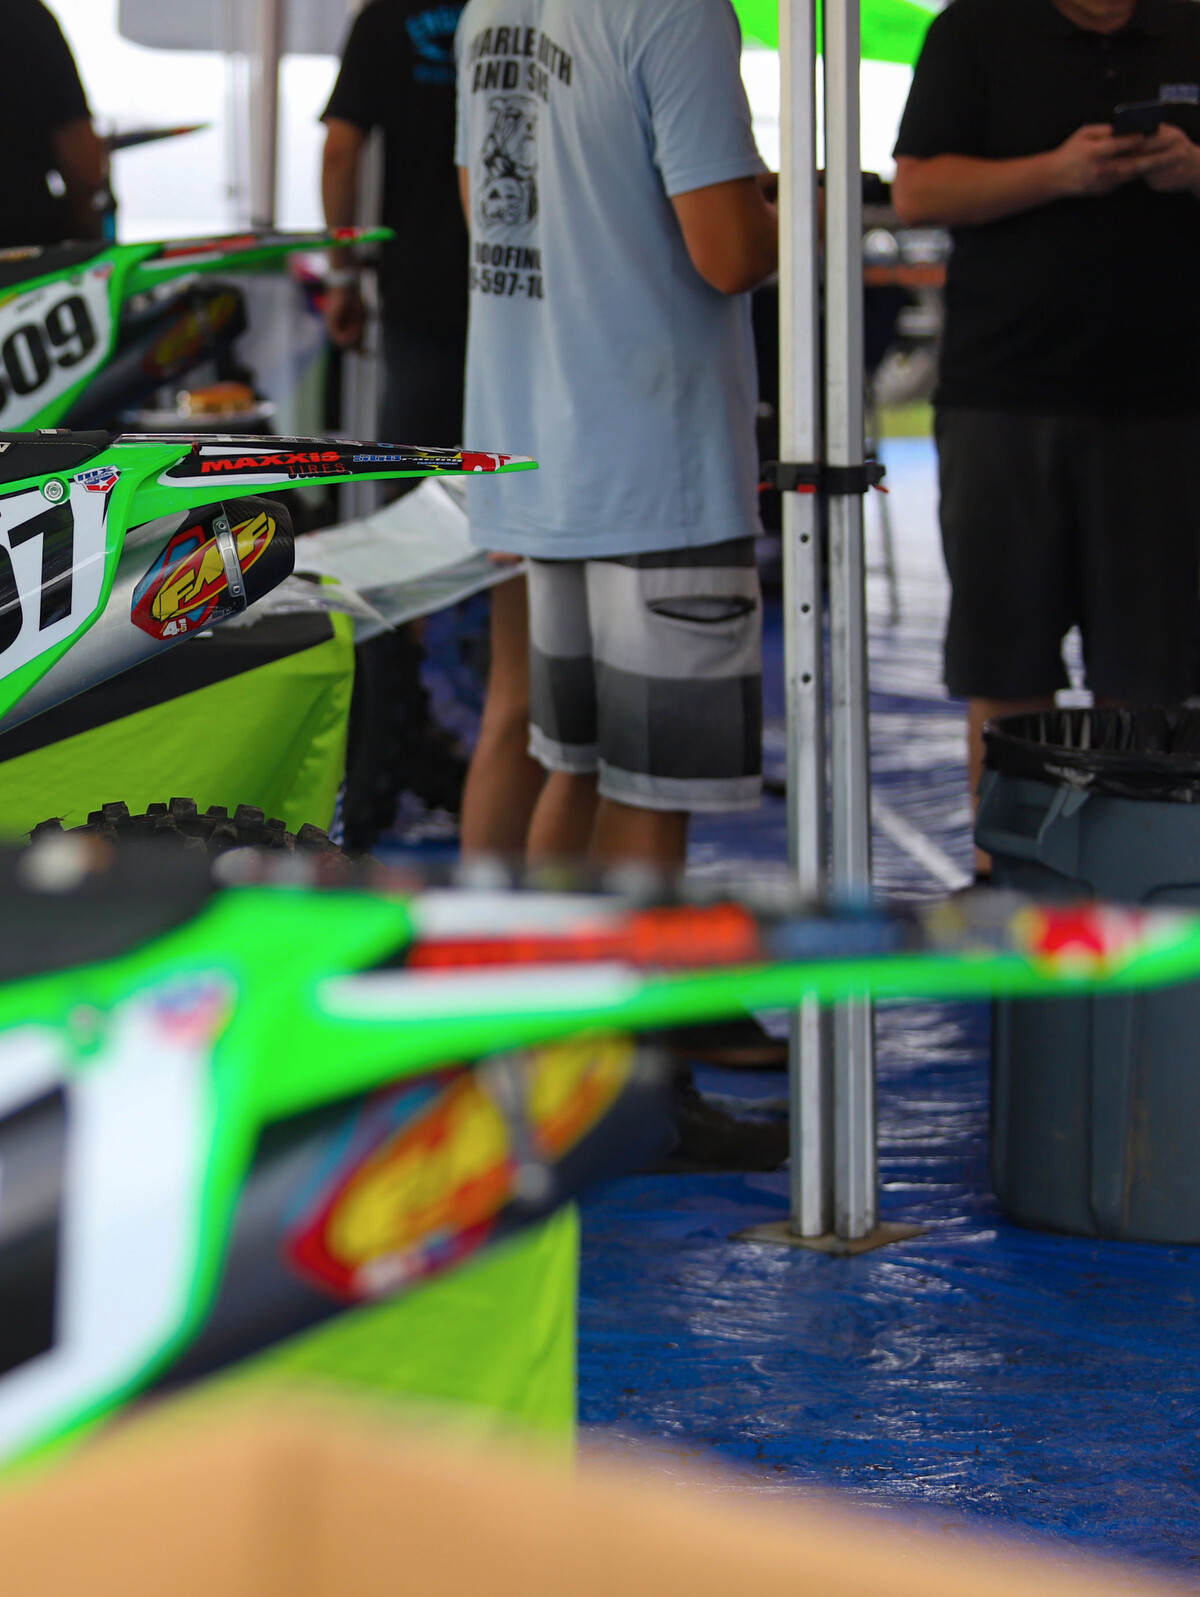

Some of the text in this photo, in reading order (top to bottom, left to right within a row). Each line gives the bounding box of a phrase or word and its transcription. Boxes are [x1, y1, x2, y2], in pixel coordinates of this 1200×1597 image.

[201, 451, 341, 473] MAXXIS
[286, 462, 346, 476] TIRES
[160, 511, 269, 622] FMF
